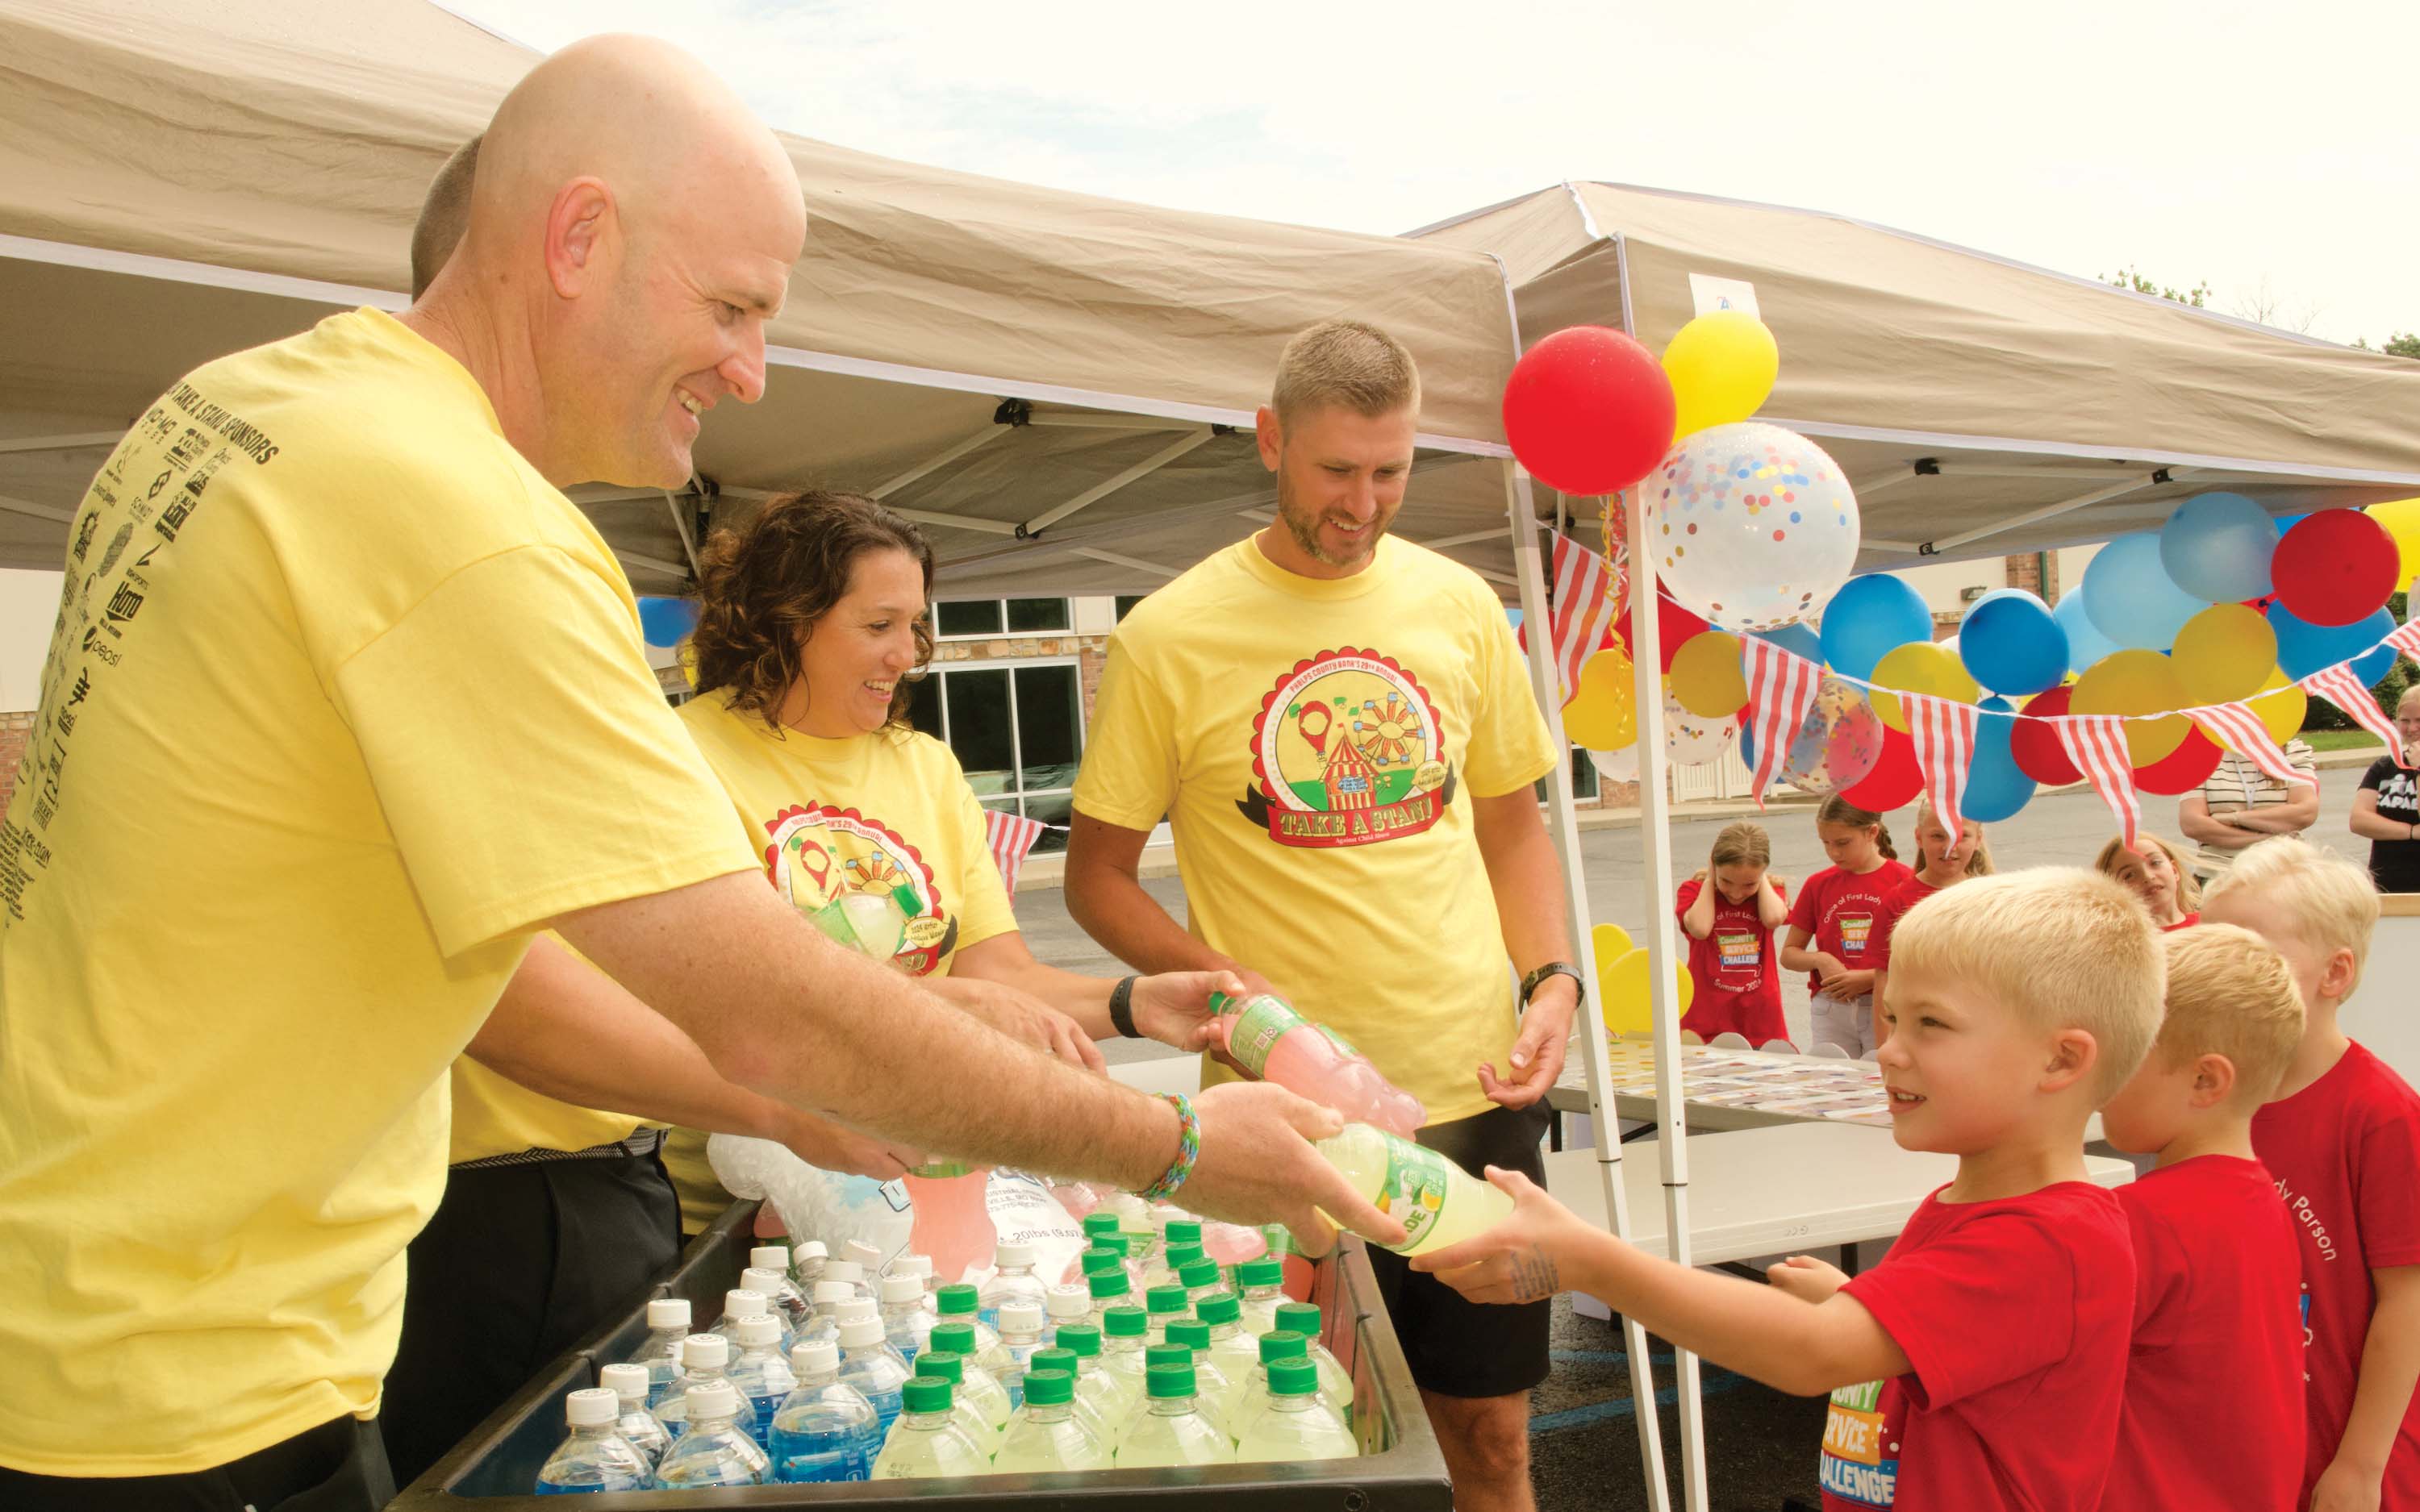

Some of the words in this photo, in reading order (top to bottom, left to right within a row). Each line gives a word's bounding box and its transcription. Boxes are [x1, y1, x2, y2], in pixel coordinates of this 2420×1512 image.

[172, 384, 200, 410] TAKE
[187, 399, 207, 416] A
[195, 404, 232, 430] STAND
[219, 417, 279, 465] SPONSORS
[91, 639, 123, 668] pepsi
[1290, 673, 1314, 693] PHELPS
[1312, 663, 1337, 677] COUNTY
[1279, 813, 1346, 837] TAKE
[1350, 813, 1369, 835] A
[1725, 910, 1741, 918] First
[1824, 904, 1838, 923] Office
[1838, 897, 1846, 905] of
[1846, 893, 1863, 901] First
[1864, 893, 1881, 905] Lady
[1714, 978, 1744, 992] Summer
[1013, 1230, 1050, 1240] 20lbs
[2292, 1196, 2337, 1261] Parson
